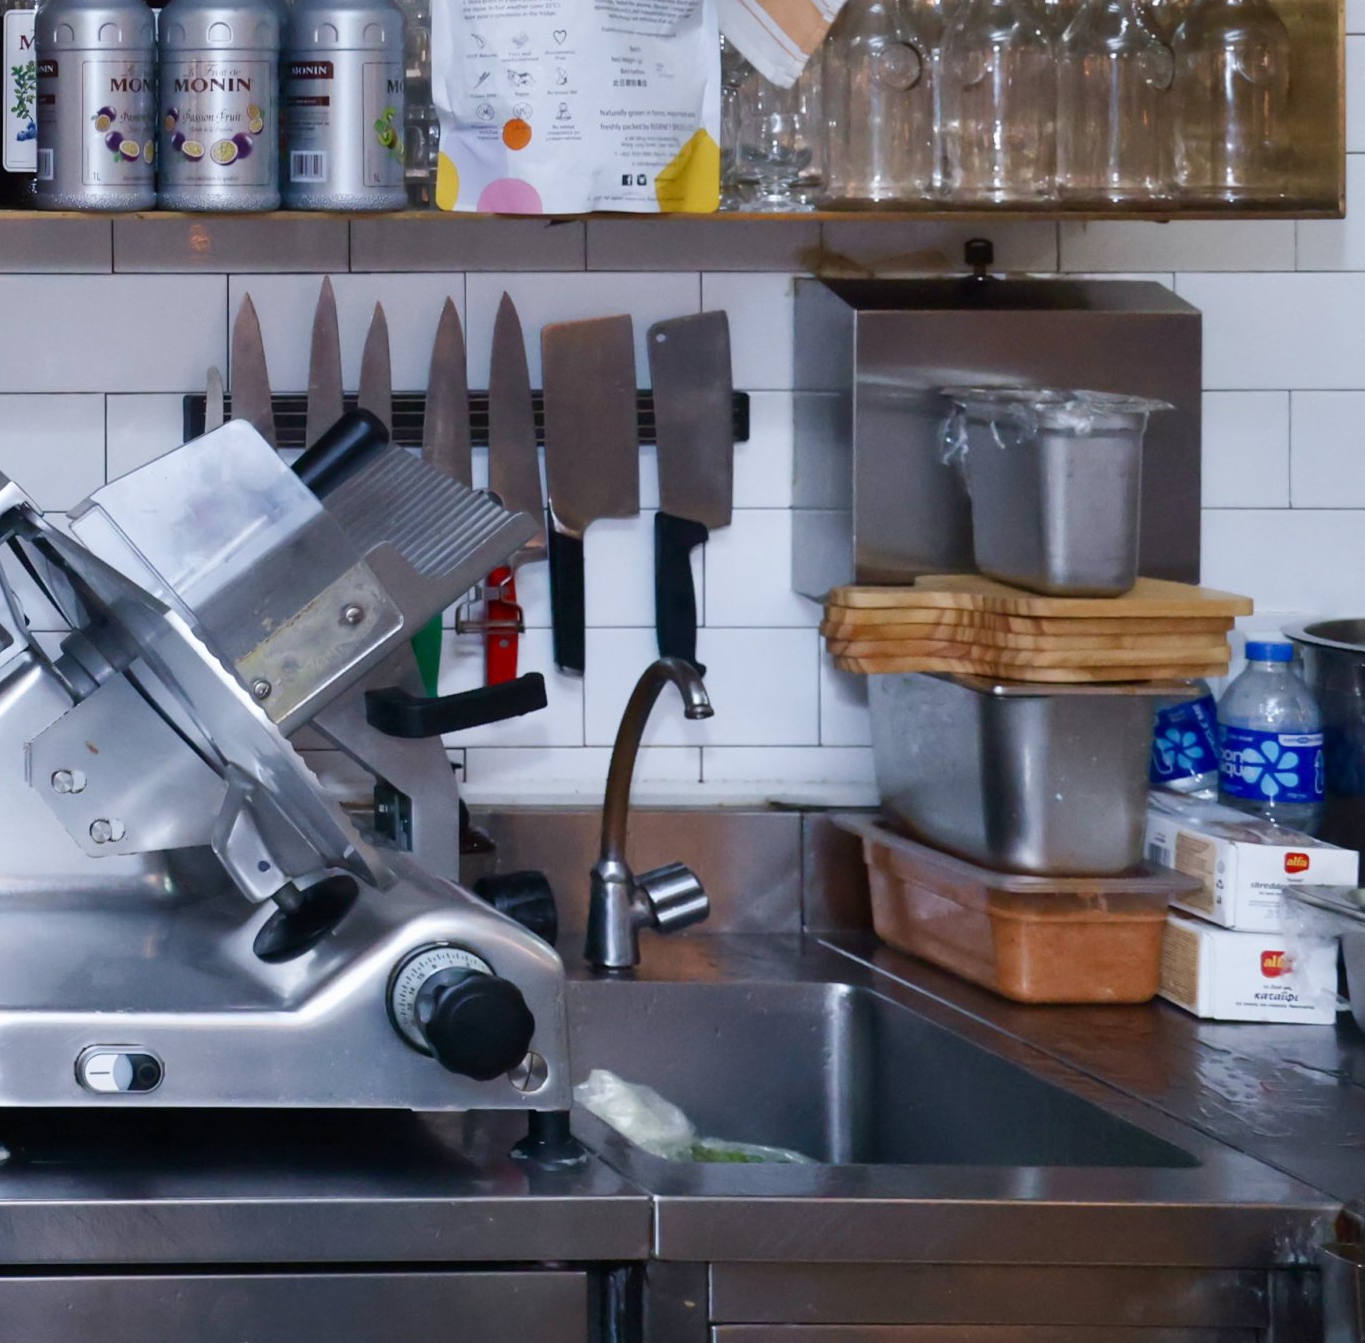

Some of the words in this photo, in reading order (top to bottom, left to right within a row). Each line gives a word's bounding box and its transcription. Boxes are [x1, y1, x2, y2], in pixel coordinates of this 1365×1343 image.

[291, 65, 328, 76] MONIN
[174, 77, 251, 93] MONIN
[182, 111, 214, 123] Passion
[217, 111, 241, 123] Fruit
[1286, 856, 1307, 867] alfa
